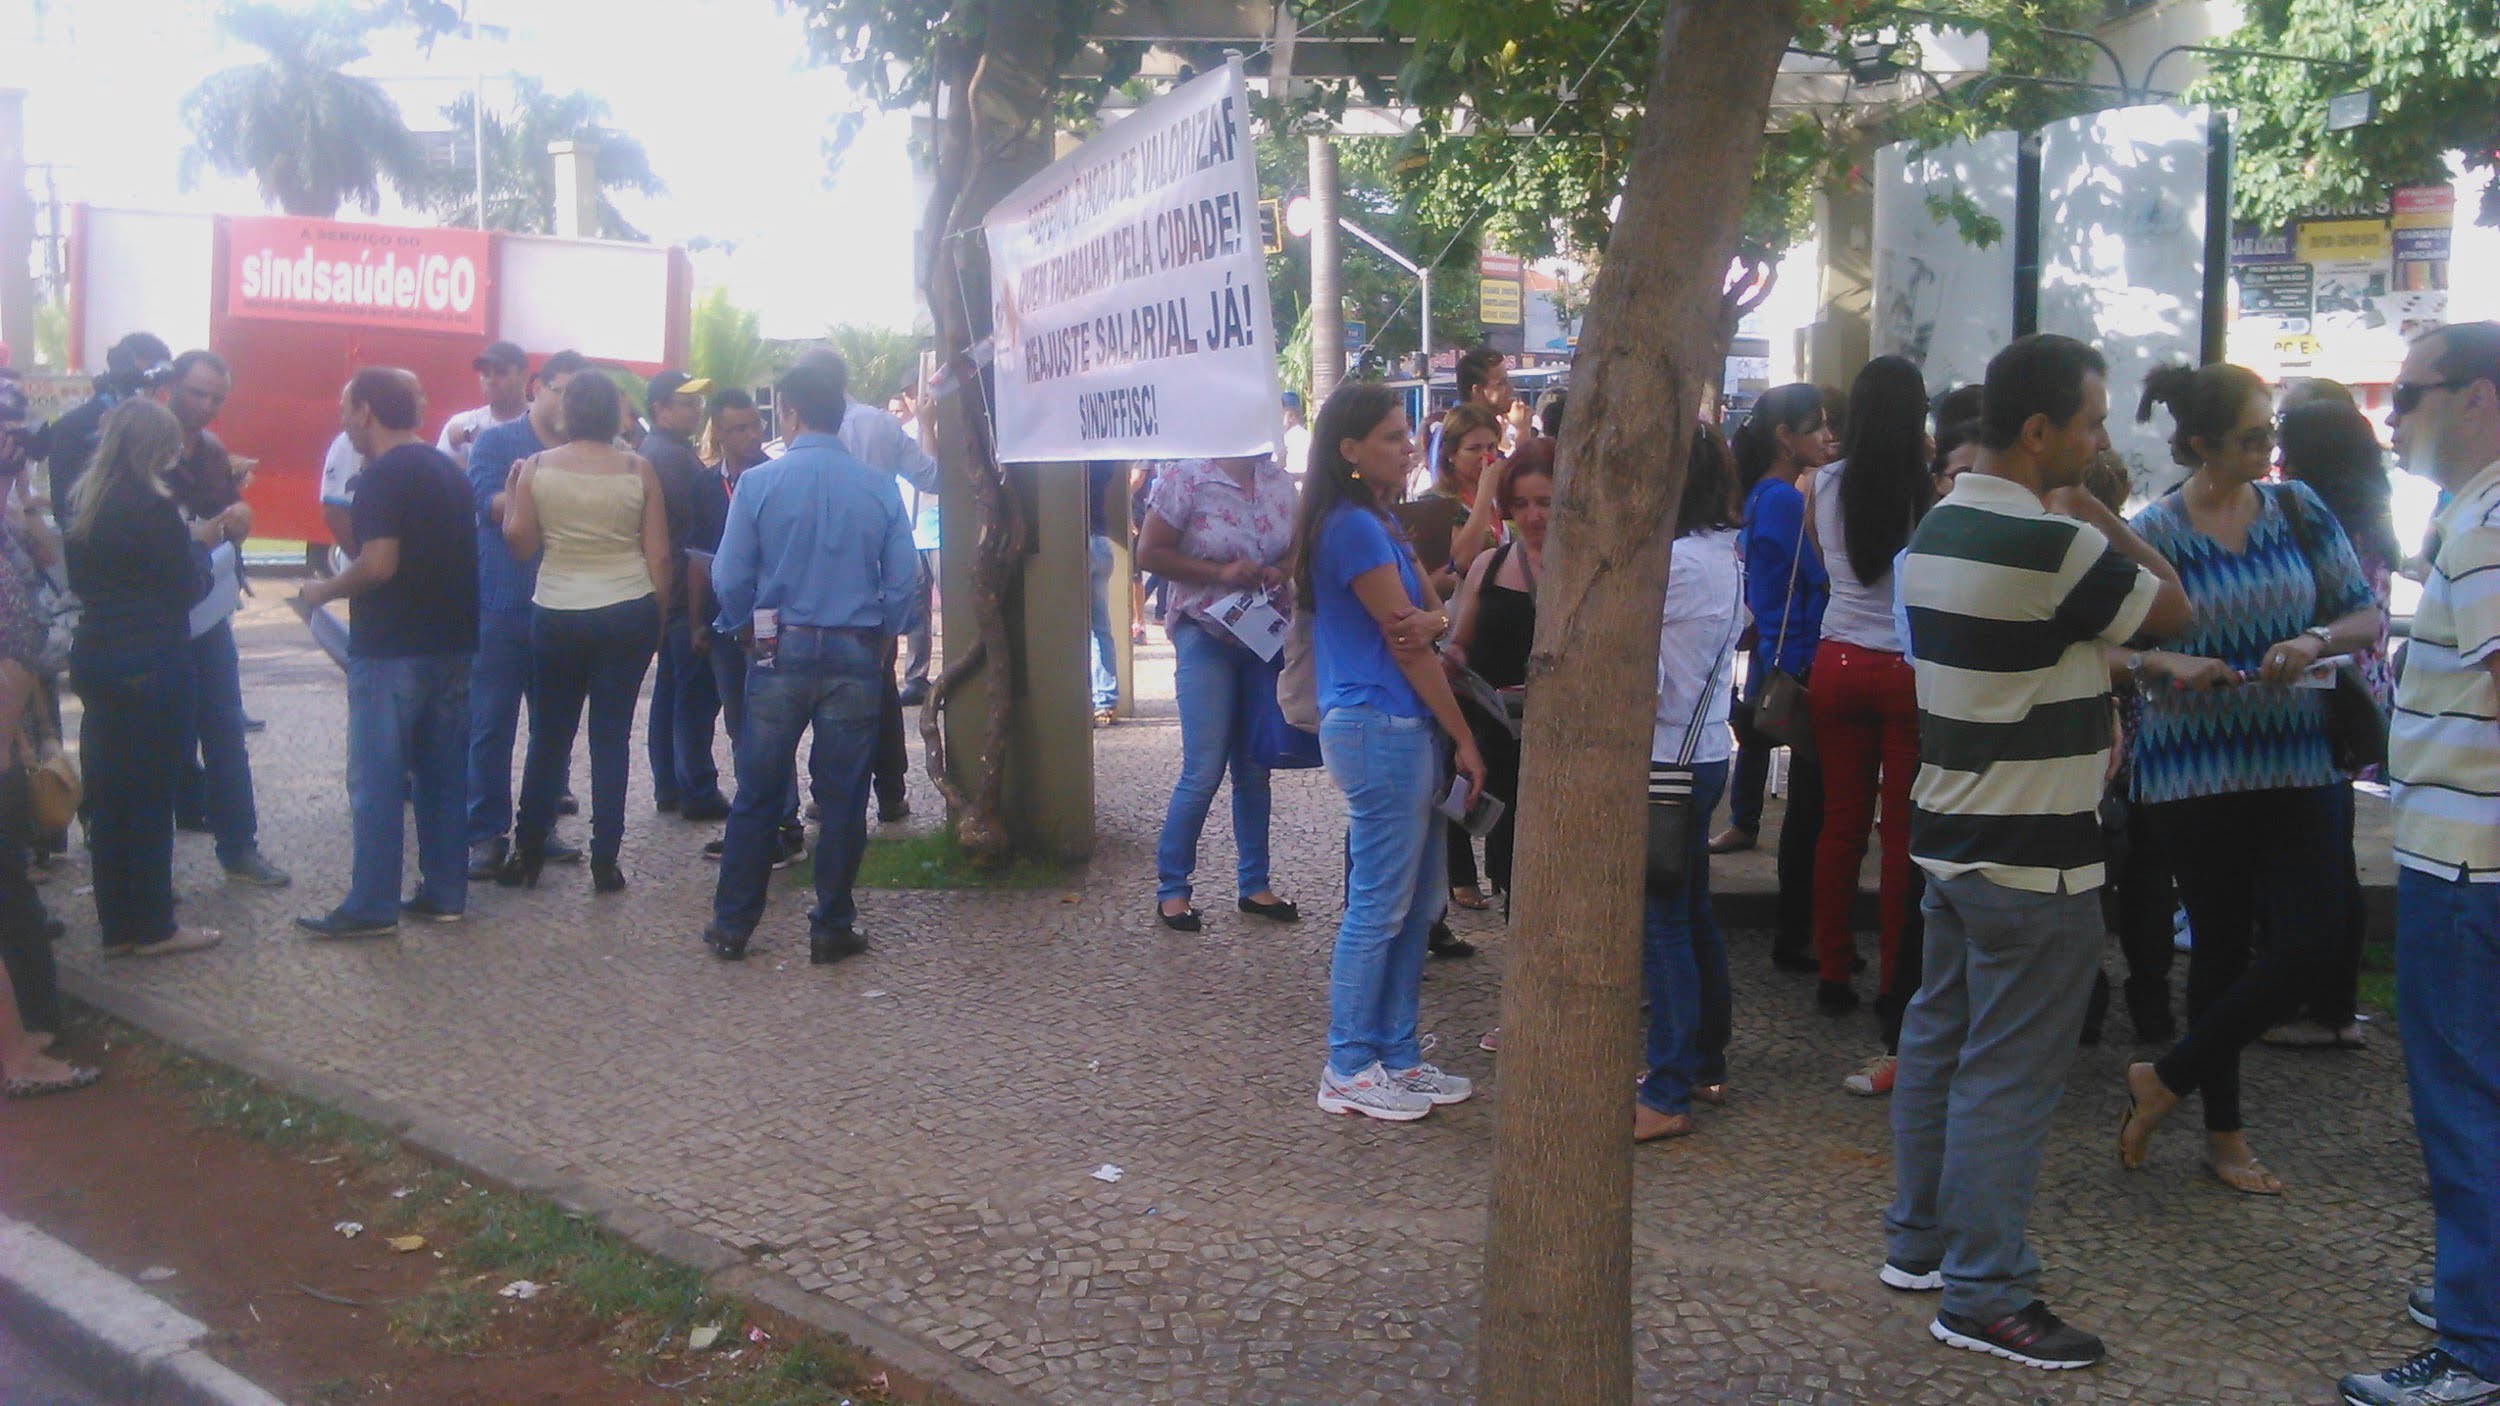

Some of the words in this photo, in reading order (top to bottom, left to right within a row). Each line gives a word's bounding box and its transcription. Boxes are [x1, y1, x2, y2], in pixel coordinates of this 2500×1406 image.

[1120, 147, 1137, 202] DE
[241, 245, 476, 313] sindsaúde/GO
[1050, 236, 1111, 302] TRABALHA
[1113, 219, 1154, 282] PELA
[1156, 191, 1243, 271] CIDADE!
[1025, 321, 1091, 384] REAJUSTE
[1096, 297, 1199, 367] SALARIAL
[1206, 271, 1254, 351] JÁ!
[1079, 384, 1160, 441] SINDIFFISC!
